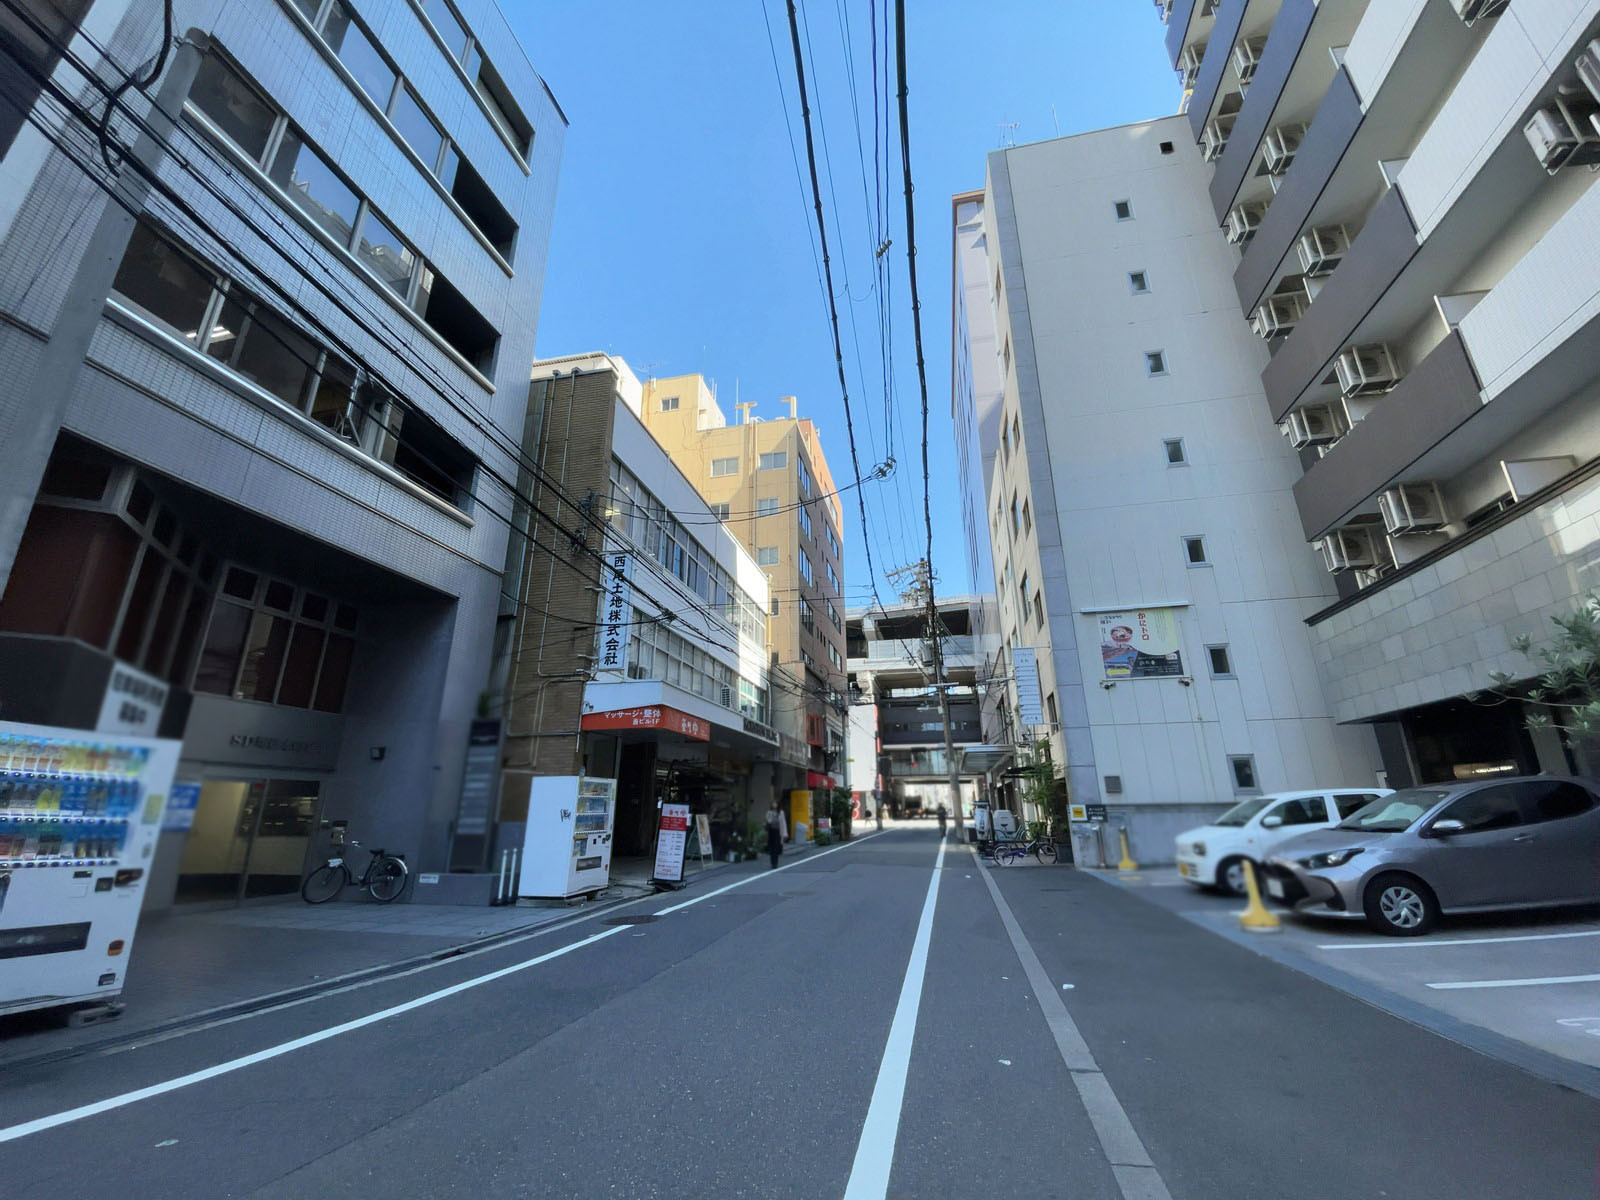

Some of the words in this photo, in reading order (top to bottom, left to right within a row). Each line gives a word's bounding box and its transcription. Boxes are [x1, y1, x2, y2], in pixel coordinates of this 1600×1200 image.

[603, 555, 627, 666] 西尾土地株式会社
